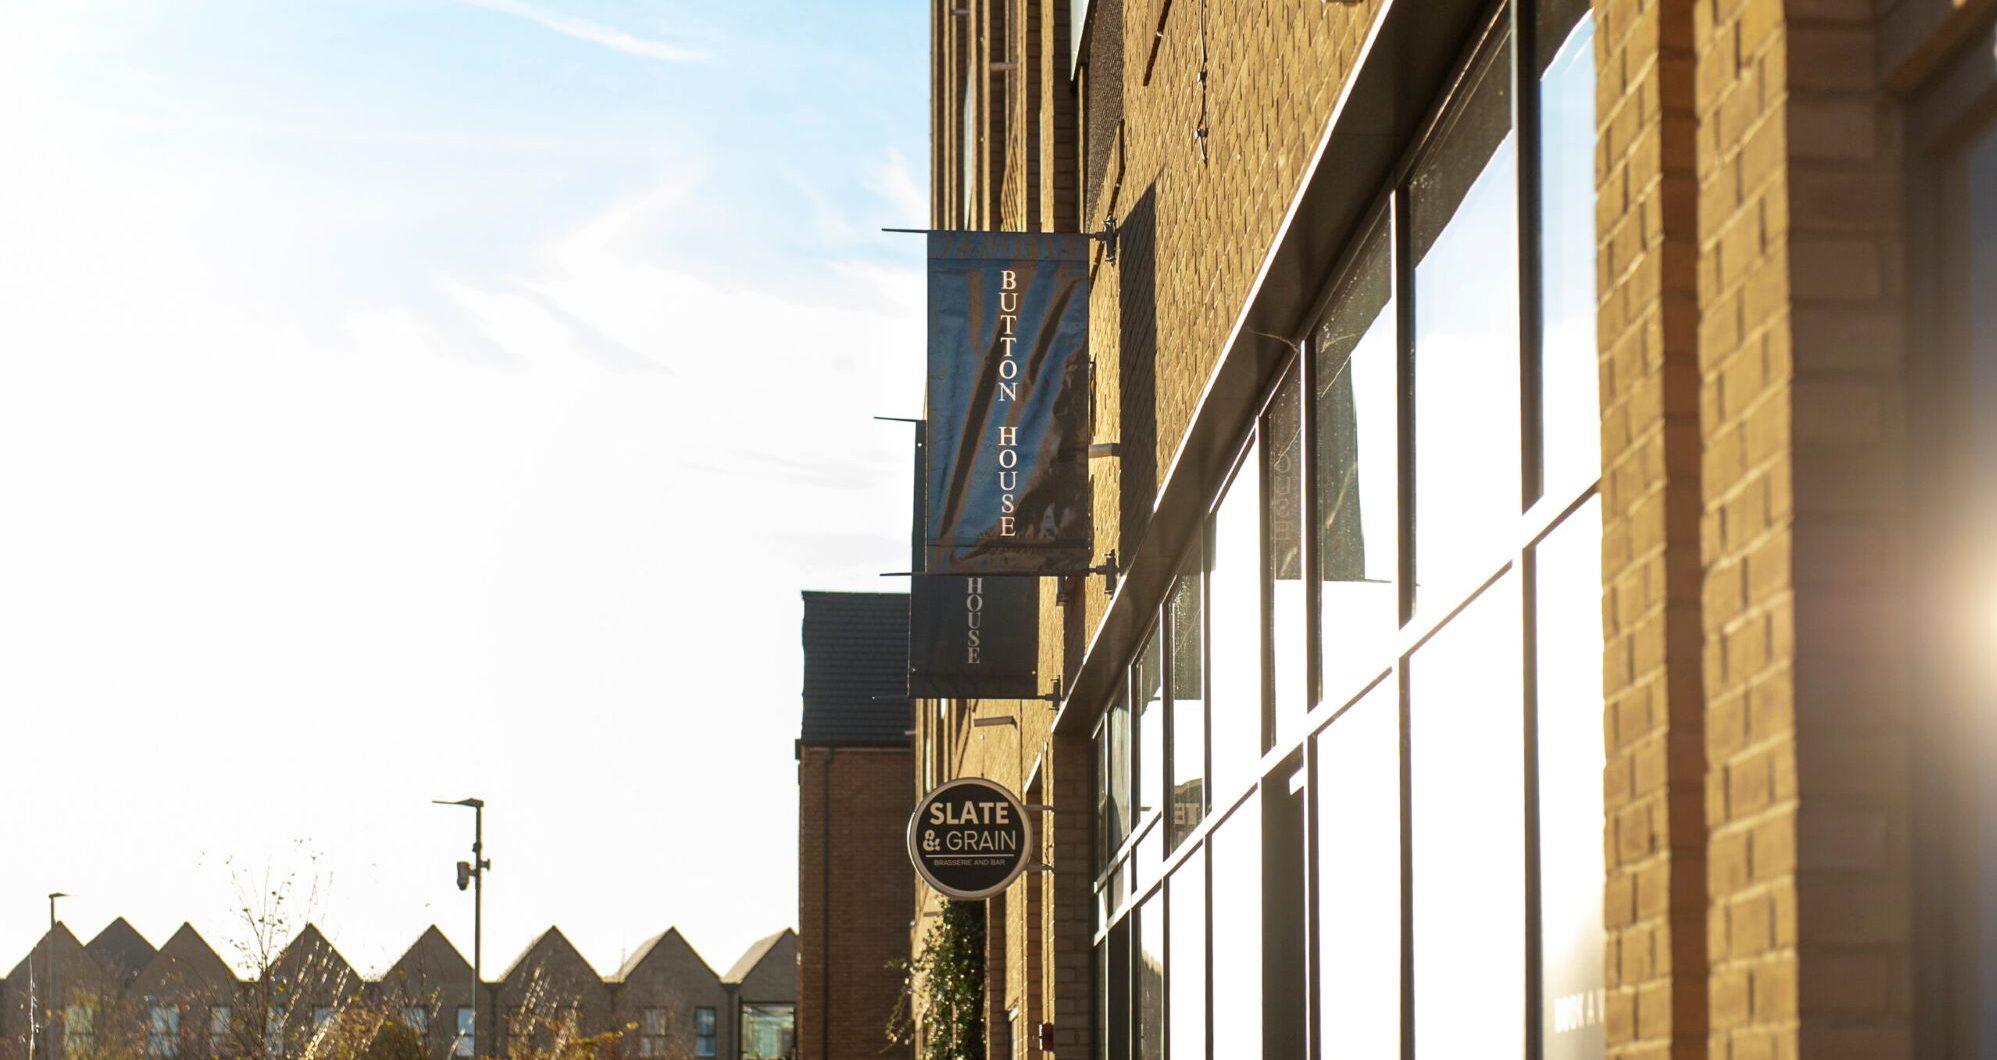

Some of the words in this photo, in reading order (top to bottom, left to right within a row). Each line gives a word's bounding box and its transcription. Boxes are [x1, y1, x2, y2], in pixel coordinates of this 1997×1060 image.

[998, 270, 1018, 402] BUTTON
[998, 426, 1018, 537] HOUSE
[966, 577, 983, 664] HOUSE
[923, 830, 940, 851] &
[946, 830, 1016, 850] GRAIN
[929, 801, 1009, 825] SLATE
[990, 858, 1005, 866] BAR
